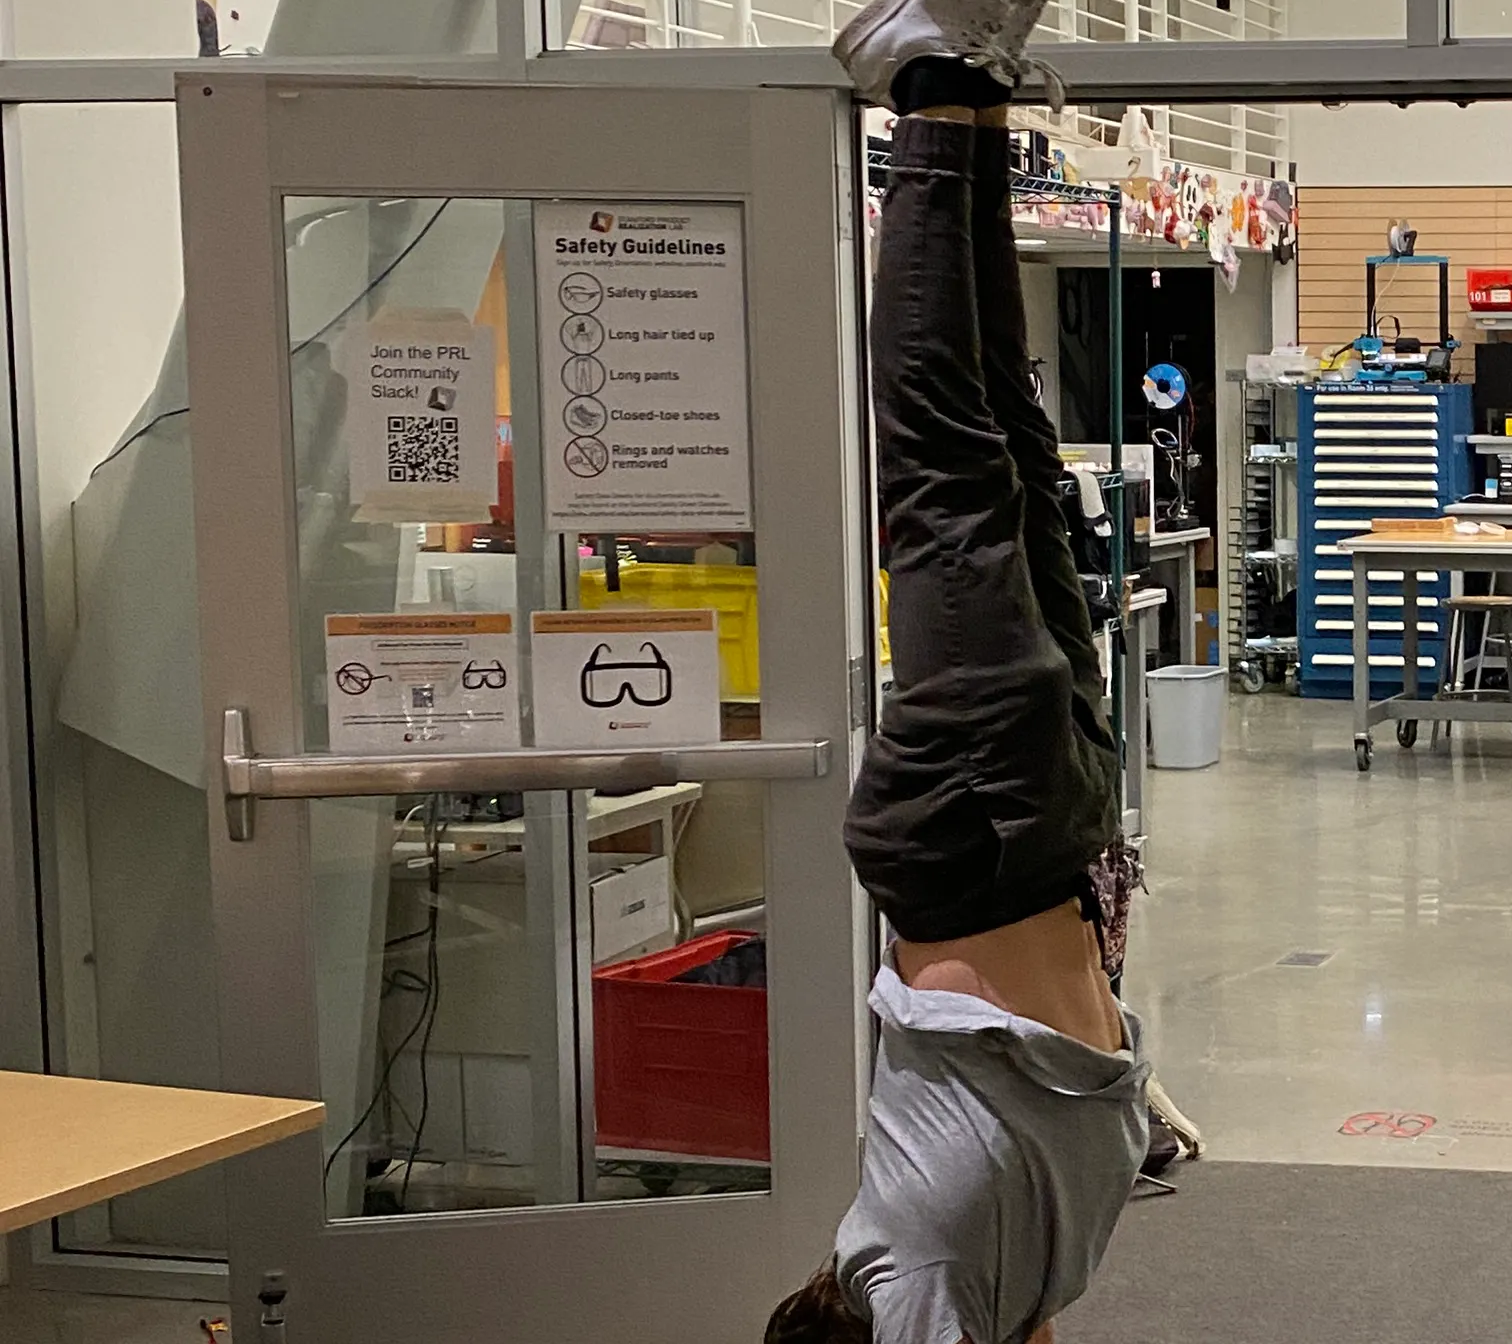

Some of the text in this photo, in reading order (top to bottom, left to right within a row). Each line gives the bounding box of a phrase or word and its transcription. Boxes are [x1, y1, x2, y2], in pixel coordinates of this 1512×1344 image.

[555, 237, 726, 257] Safety Guidelines
[606, 287, 698, 301] Safety glasses
[1469, 290, 1487, 302] 101
[609, 329, 715, 342] Long hair tied up
[370, 345, 471, 360] Join the PRL
[370, 364, 460, 383] Community
[609, 370, 680, 383] Long pants
[371, 384, 419, 399] Slack!
[610, 409, 720, 421] Closed-toe shoes
[612, 445, 729, 457] Rings and watches
[612, 458, 668, 469] removed
